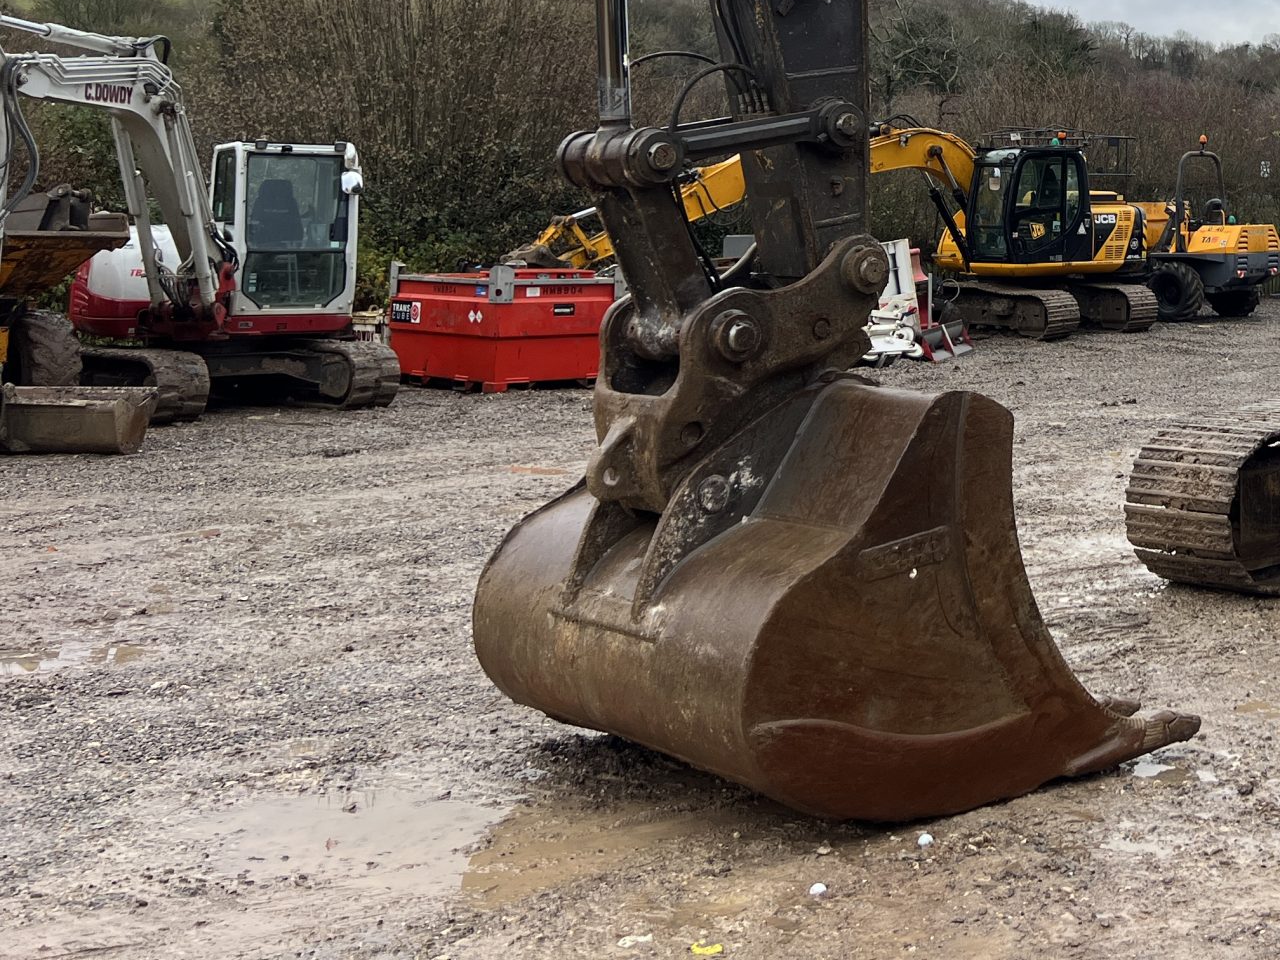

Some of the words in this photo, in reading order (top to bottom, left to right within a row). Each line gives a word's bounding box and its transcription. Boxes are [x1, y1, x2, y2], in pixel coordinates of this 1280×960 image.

[84, 83, 133, 105] C.DOWDY
[1094, 214, 1116, 224] JCB
[392, 303, 411, 312] TRANS
[392, 311, 410, 321] CUBE
